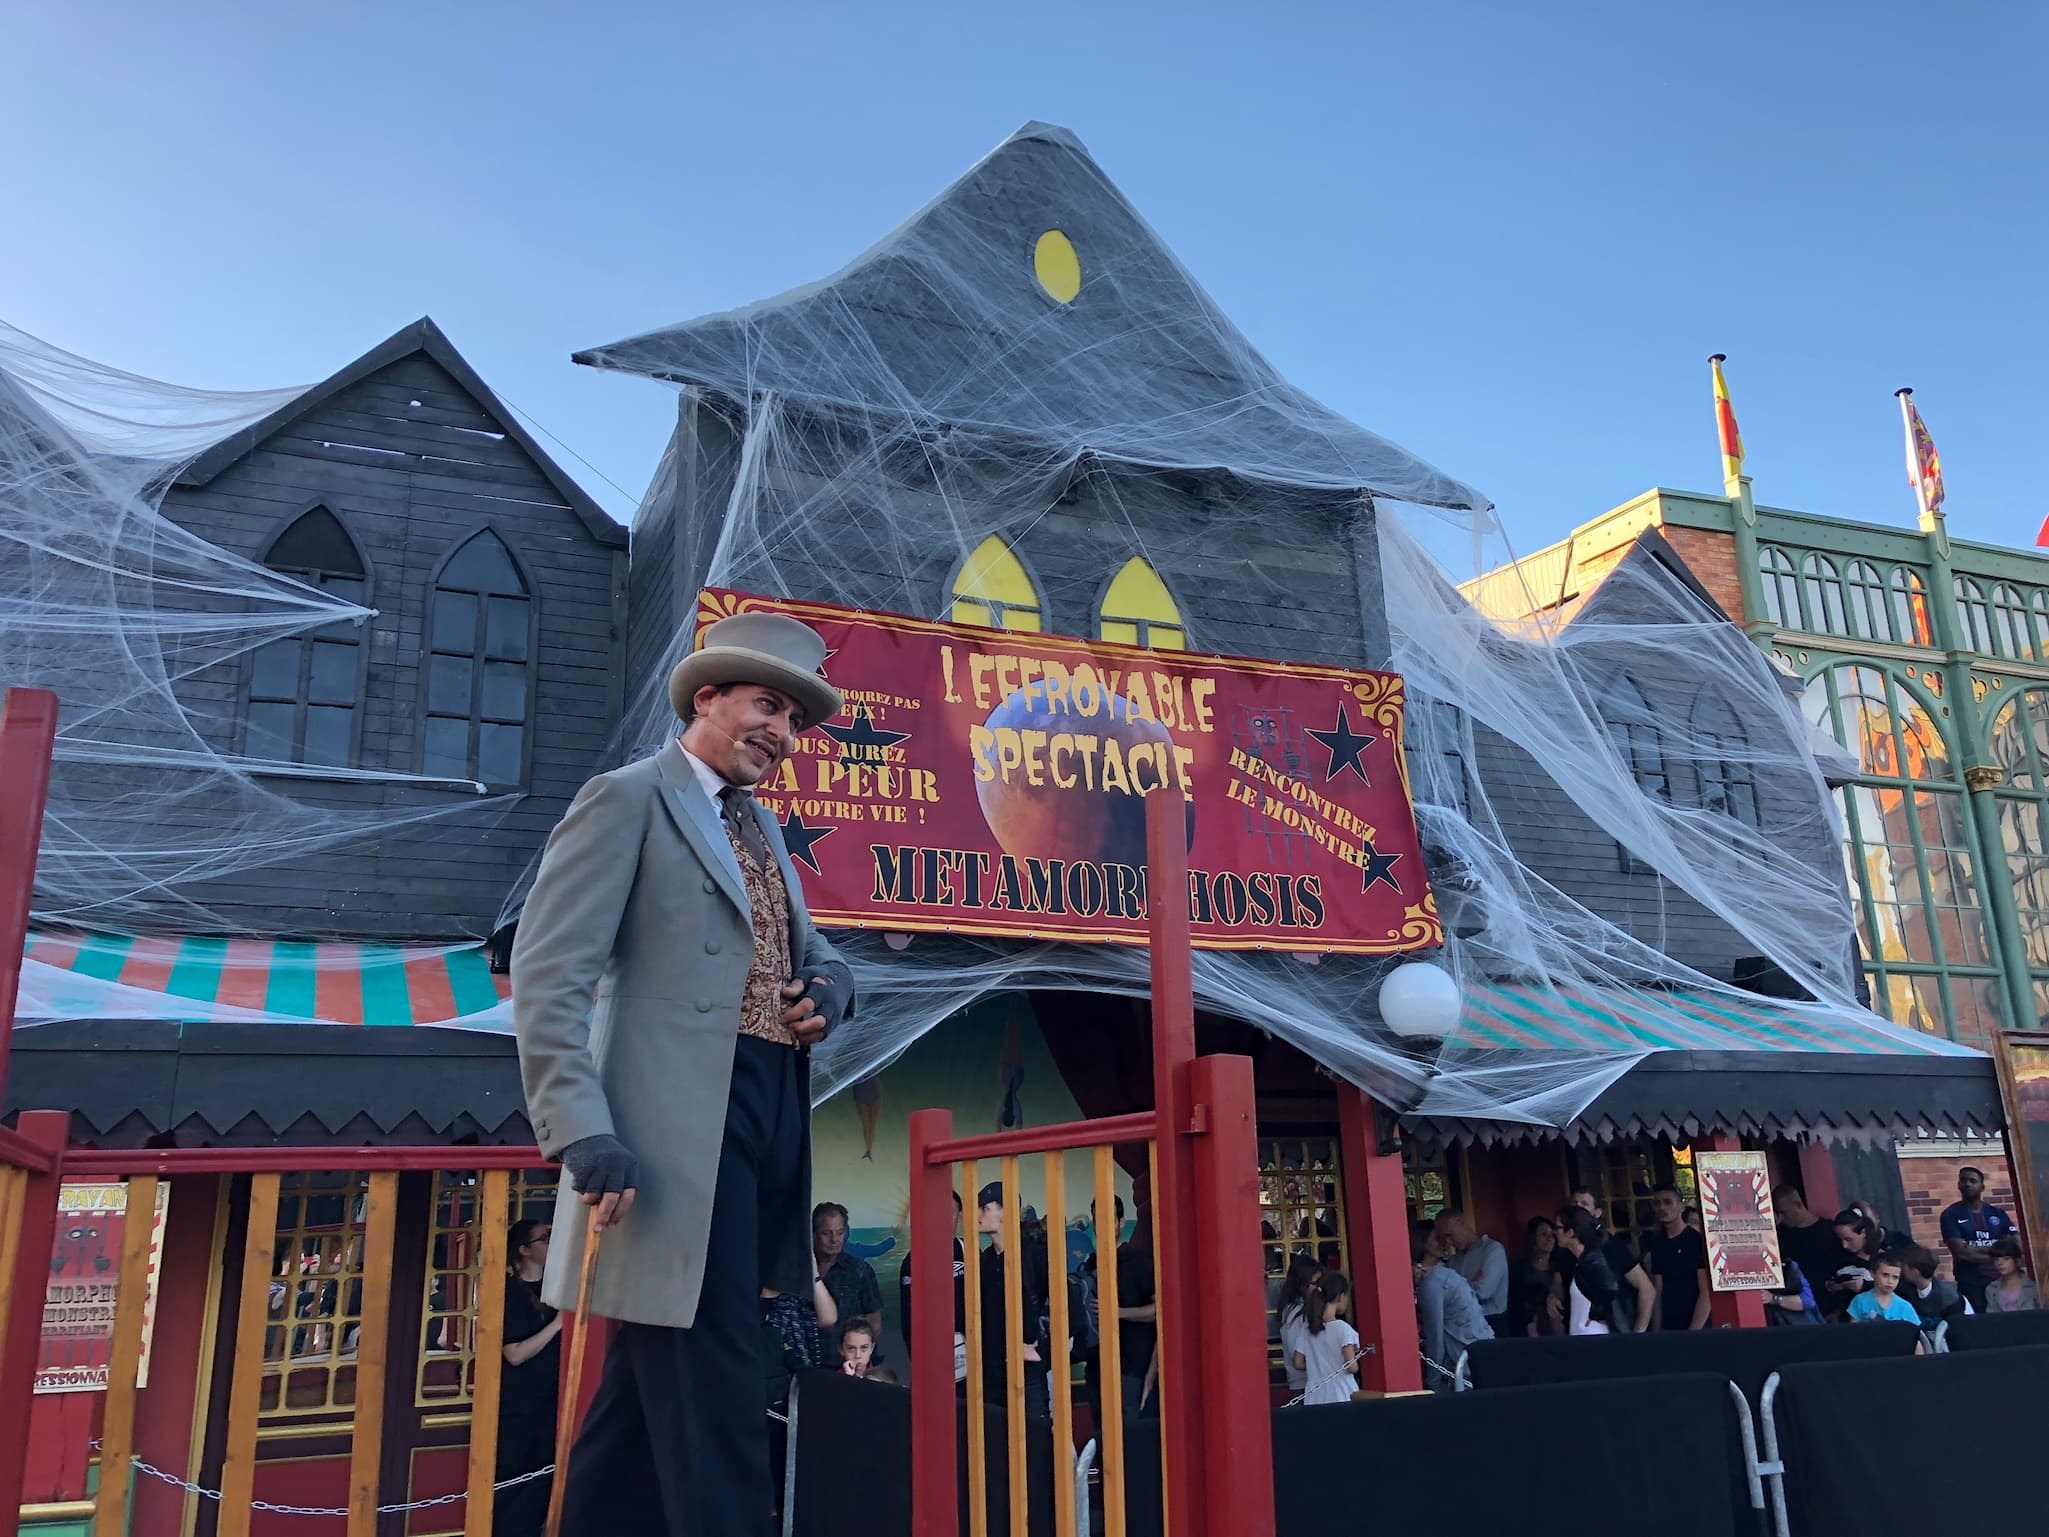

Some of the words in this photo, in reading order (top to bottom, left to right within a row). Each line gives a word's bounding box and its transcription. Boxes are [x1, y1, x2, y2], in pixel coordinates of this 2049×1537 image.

[833, 686, 892, 706] ROIREZ
[894, 696, 921, 710] PAS
[839, 703, 876, 720] EUX
[790, 737, 831, 755] OUS
[837, 742, 906, 763] AUREZ
[968, 724, 1194, 802] SPECTACLE
[815, 759, 941, 803] PEUR
[1228, 746, 1377, 845] RENCONTREZ
[790, 798, 864, 821] VOTRE
[870, 804, 907, 823] VIE
[1226, 778, 1258, 809] LE
[1260, 795, 1371, 871] MONSTRE
[870, 844, 1326, 929] METAMORHOSIS
